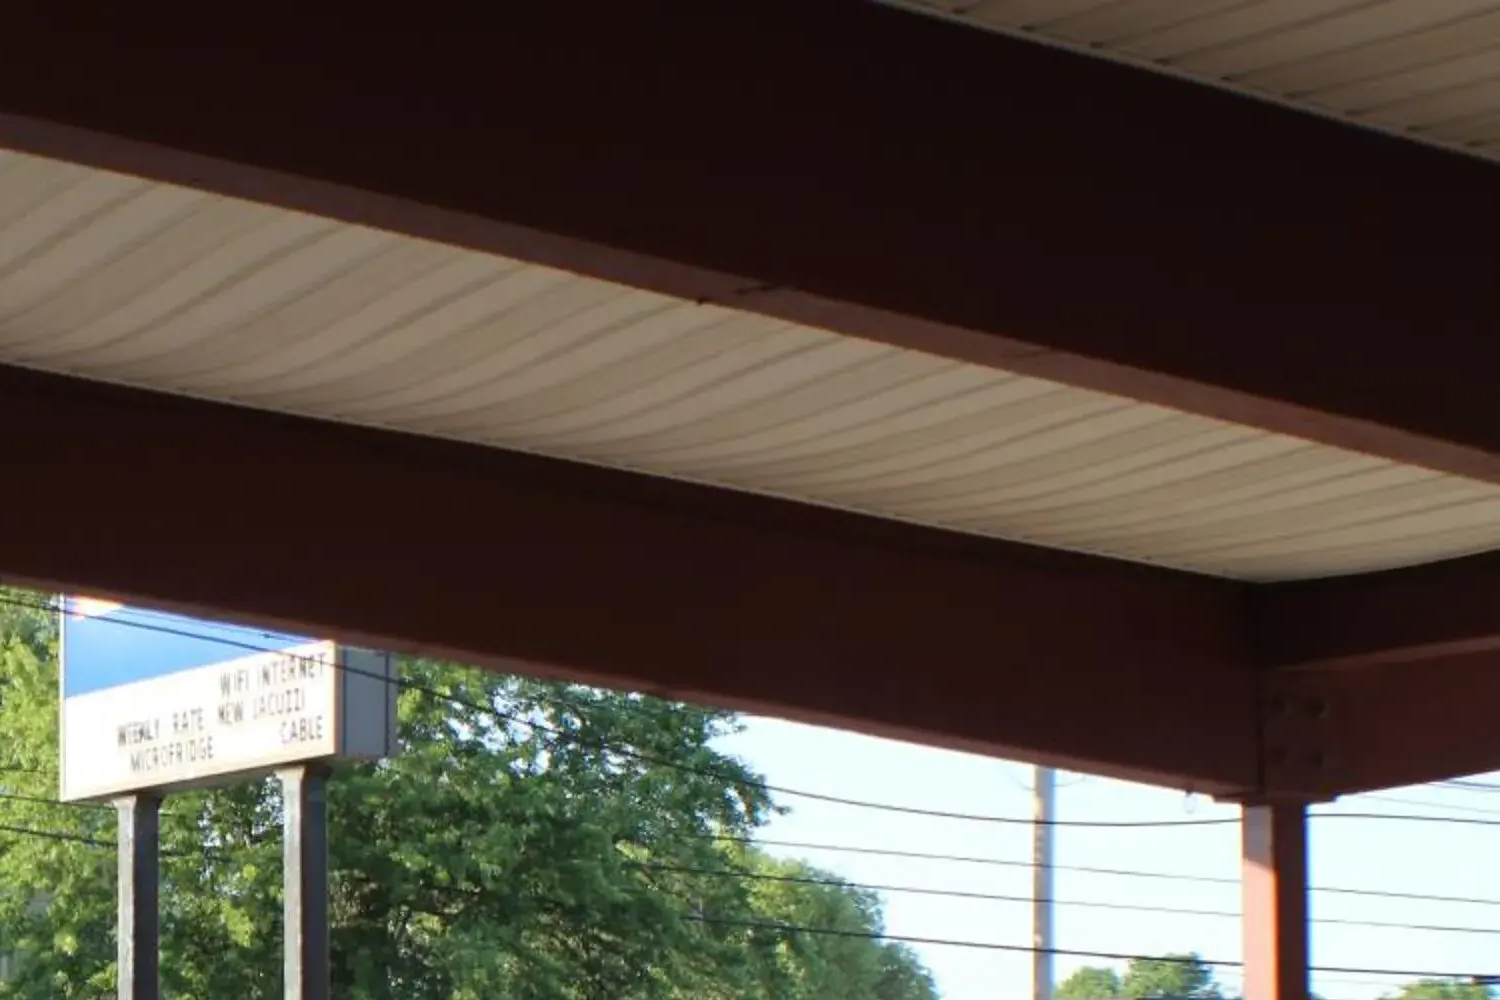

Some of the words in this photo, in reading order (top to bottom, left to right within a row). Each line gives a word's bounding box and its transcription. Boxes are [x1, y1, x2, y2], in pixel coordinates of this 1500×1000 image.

[219, 669, 249, 700] WIFI
[257, 652, 326, 690] INTERNET
[172, 706, 204, 735] RATE
[217, 699, 244, 726] NEW
[279, 715, 323, 744] CABLE
